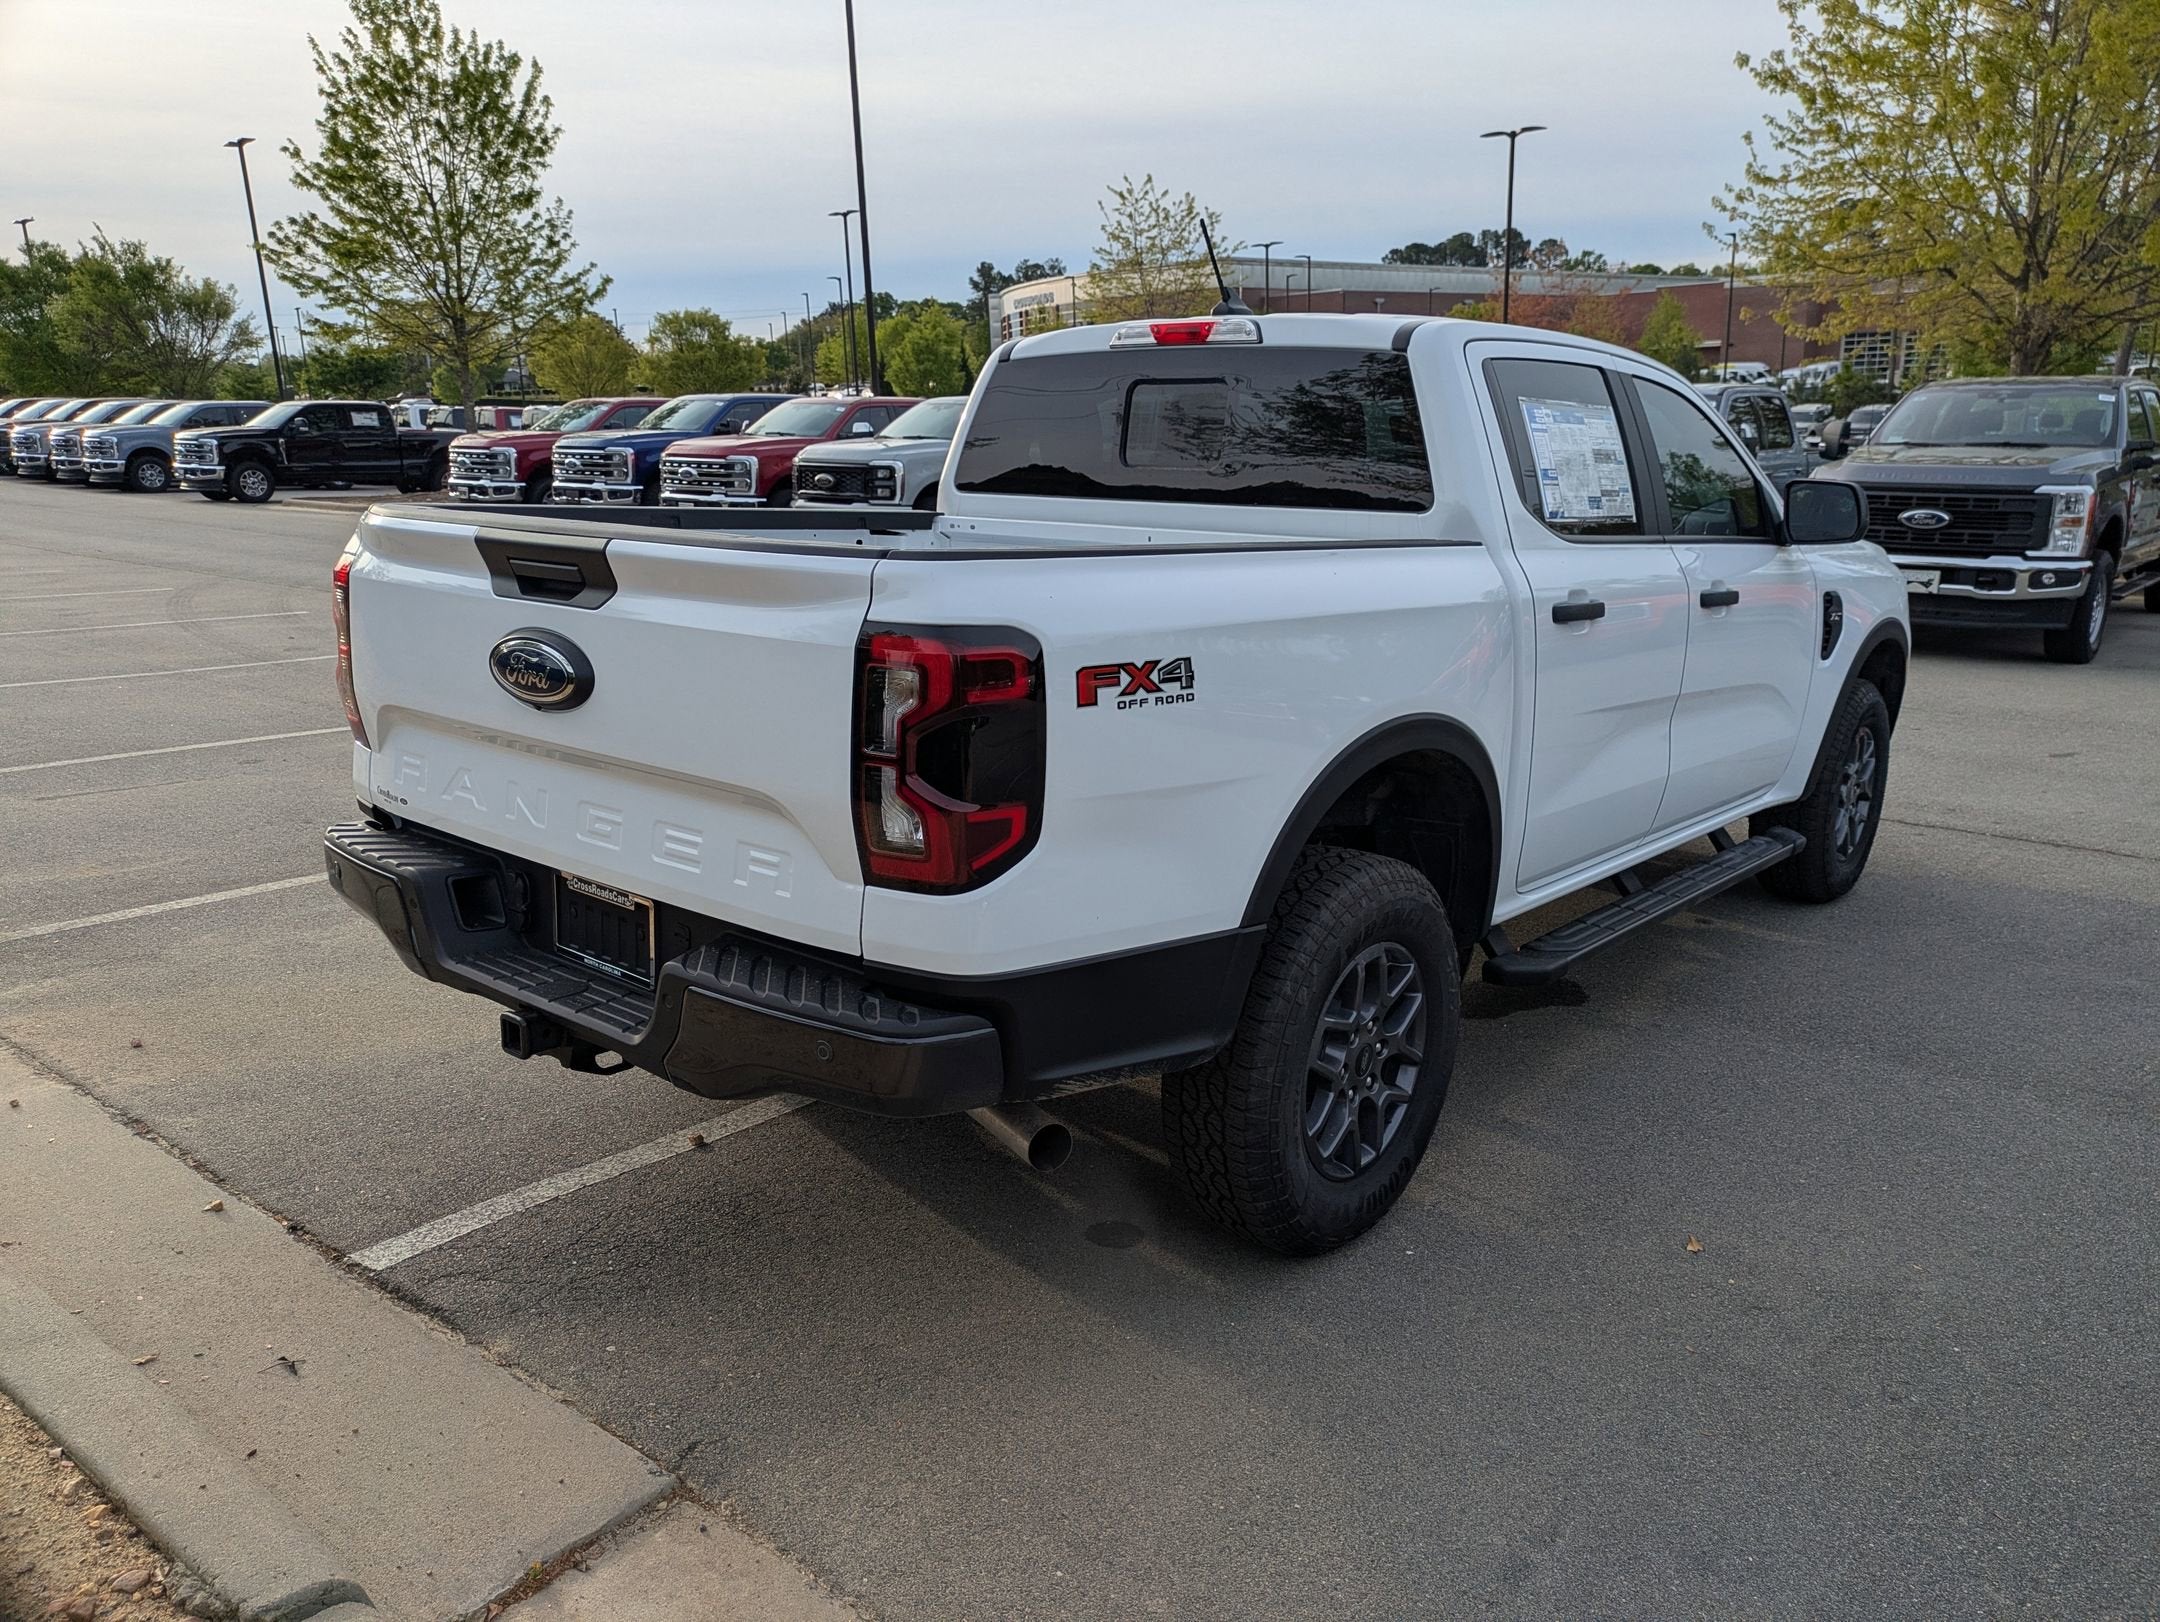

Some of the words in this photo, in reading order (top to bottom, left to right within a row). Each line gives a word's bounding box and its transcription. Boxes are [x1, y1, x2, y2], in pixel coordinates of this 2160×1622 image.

[506, 651, 550, 690] Ford
[1076, 656, 1194, 708] FX4
[1116, 697, 1149, 710] OFF
[1154, 692, 1195, 706] ROAD
[394, 753, 792, 898] RANGER
[573, 877, 630, 906] CrossRoadsCars
[583, 957, 599, 968] NORTH
[599, 963, 622, 977] CAROLINA
